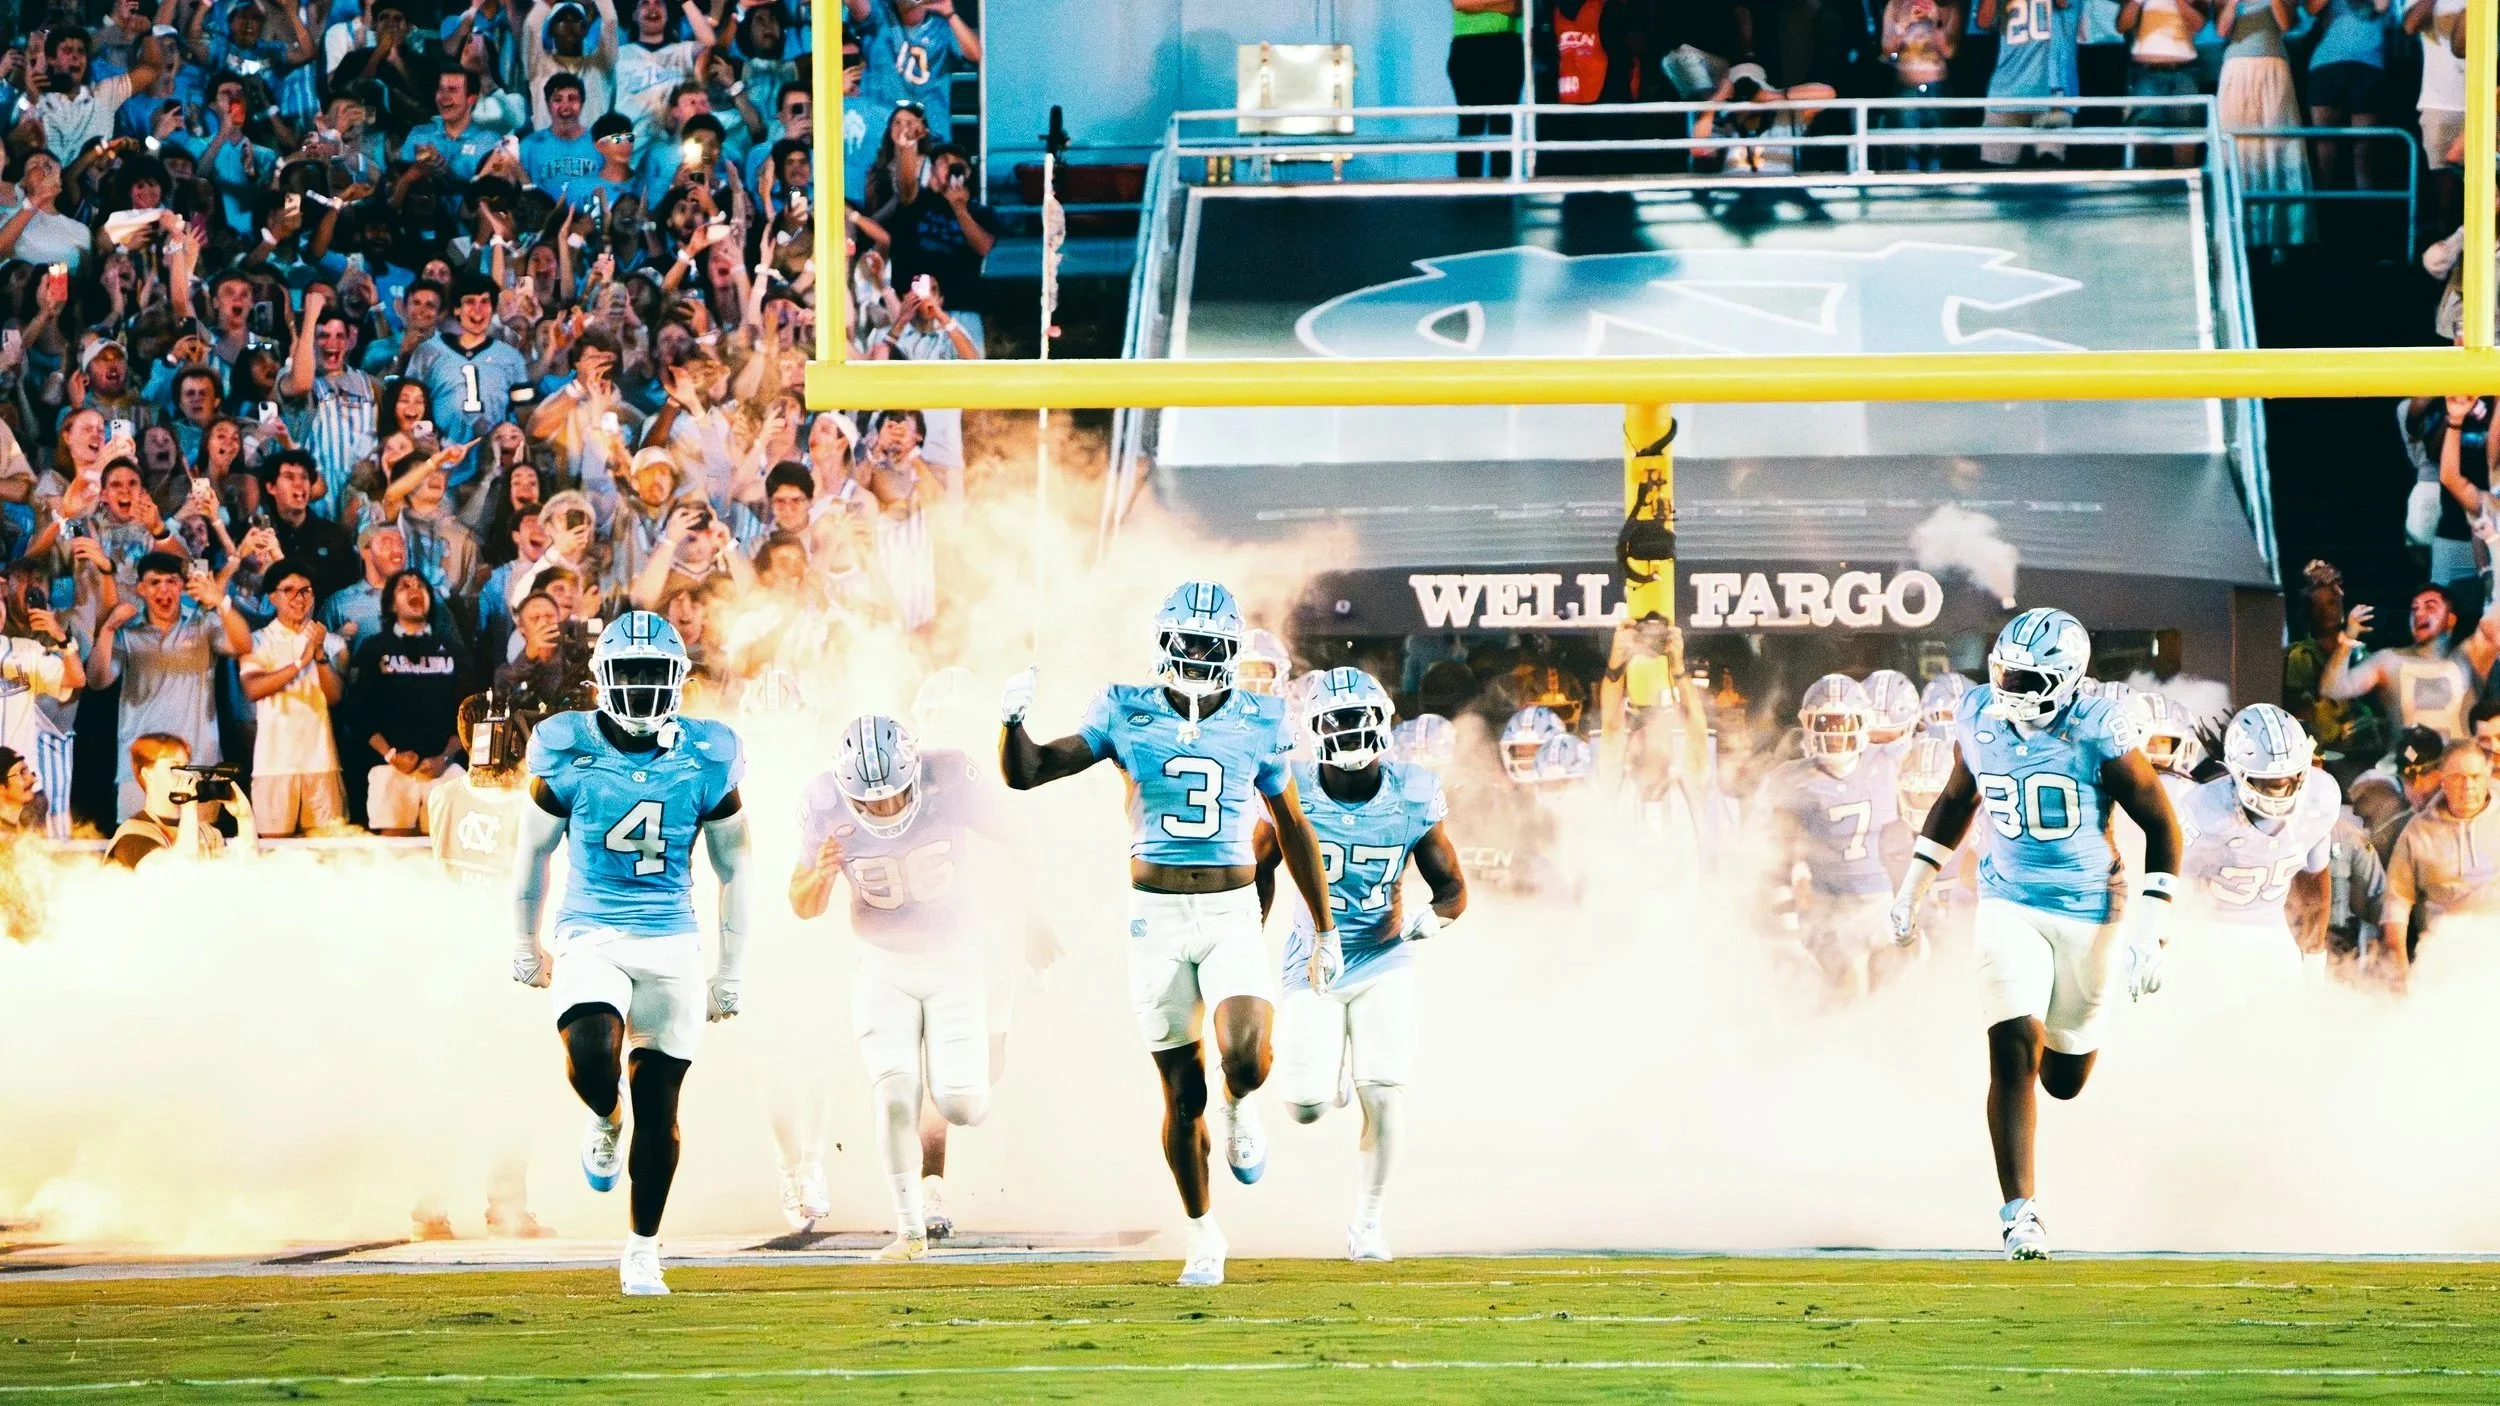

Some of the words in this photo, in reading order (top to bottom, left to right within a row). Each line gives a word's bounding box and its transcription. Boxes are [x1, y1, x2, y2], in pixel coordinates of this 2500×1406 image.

[2004, 0, 2052, 45] 20
[462, 364, 481, 412] 1
[1408, 573, 1628, 629] WELL
[1690, 570, 1944, 628] FARGO
[1161, 756, 1224, 839] 3
[1978, 772, 2081, 842] 80
[604, 799, 667, 877] 4
[1458, 846, 1514, 867] CCN
[1828, 800, 1871, 860] 7
